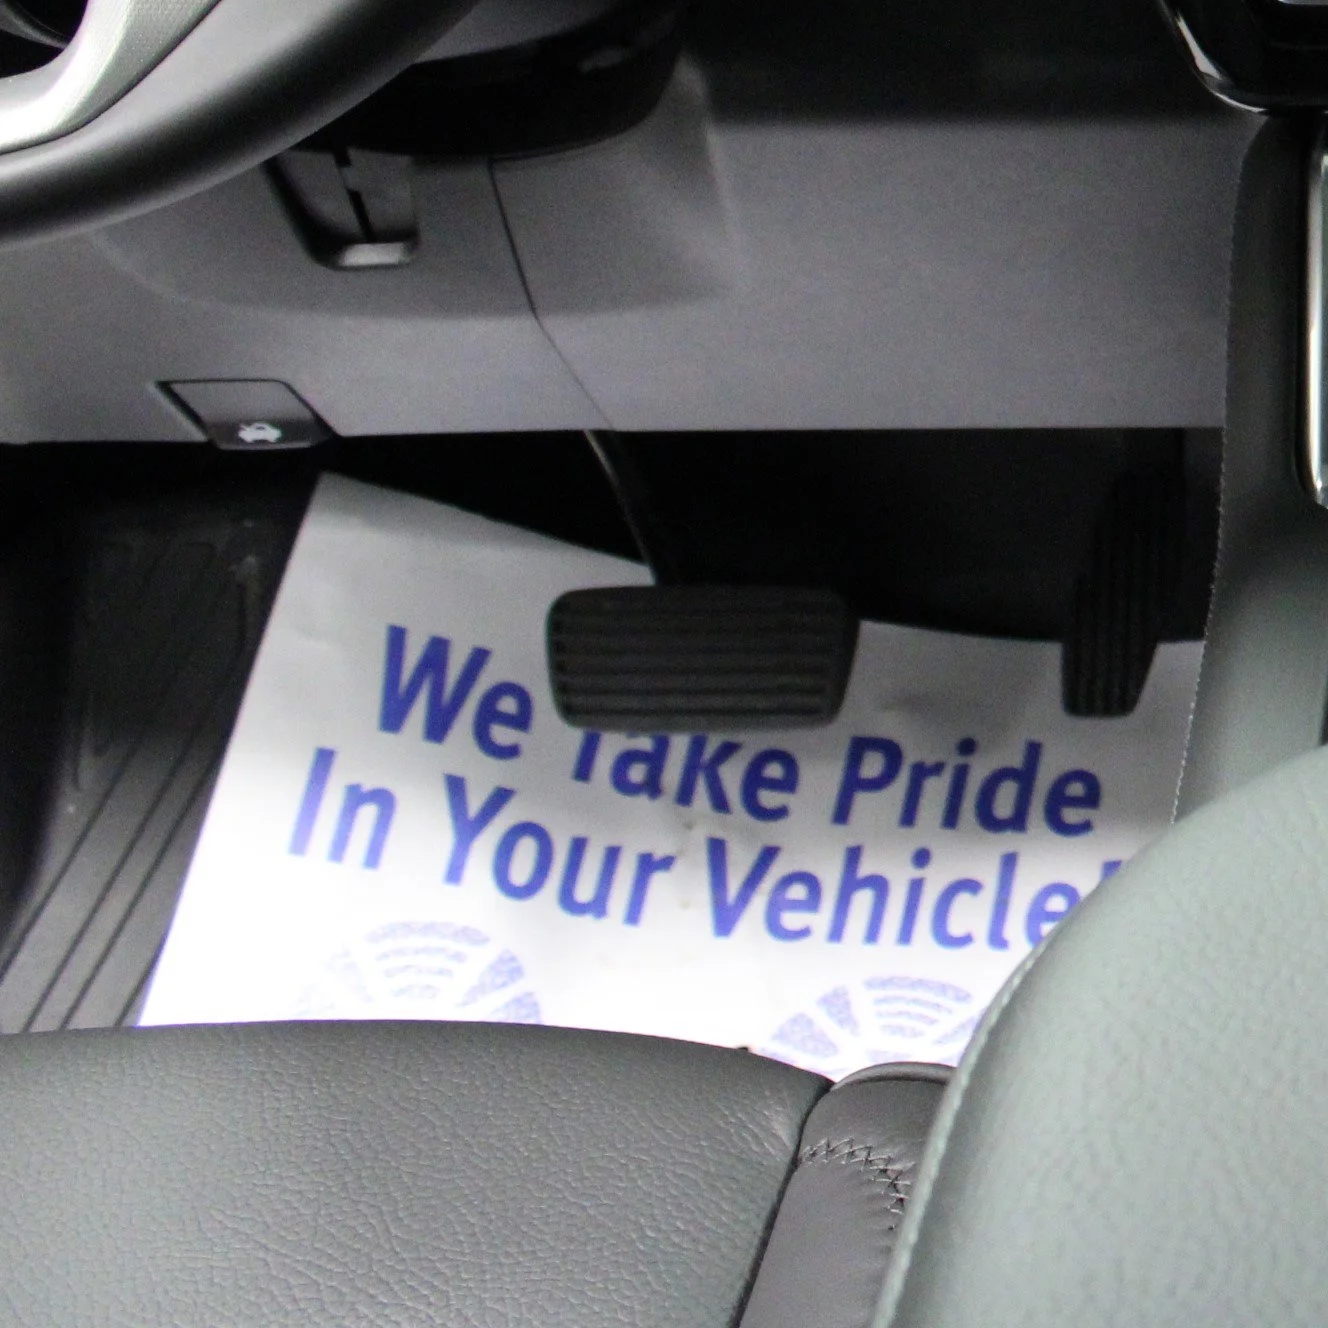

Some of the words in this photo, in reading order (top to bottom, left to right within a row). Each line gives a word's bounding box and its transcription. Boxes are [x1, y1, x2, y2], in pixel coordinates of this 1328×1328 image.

[378, 623, 533, 761] We
[832, 737, 1101, 838] Pride
[288, 746, 398, 871] In
[442, 773, 677, 928] Your
